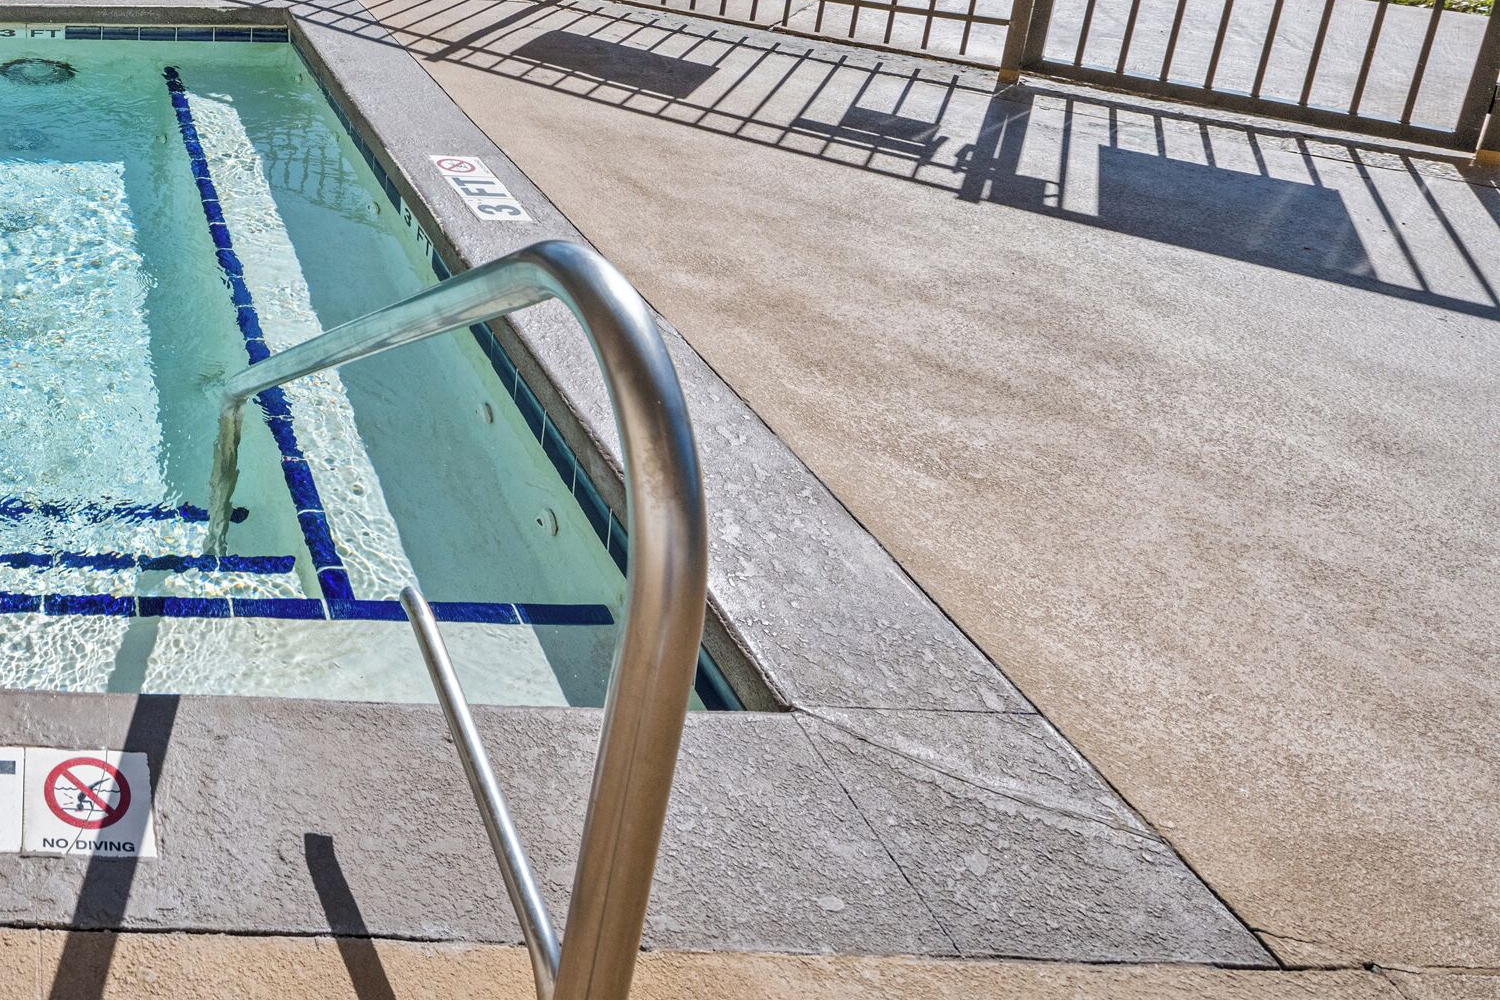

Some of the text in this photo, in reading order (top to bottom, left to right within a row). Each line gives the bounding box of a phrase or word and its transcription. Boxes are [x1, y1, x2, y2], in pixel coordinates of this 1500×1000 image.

[0, 29, 16, 37] 3
[452, 177, 521, 216] 3 FT
[404, 208, 432, 256] 3 FT
[42, 837, 135, 853] NO DIVING
